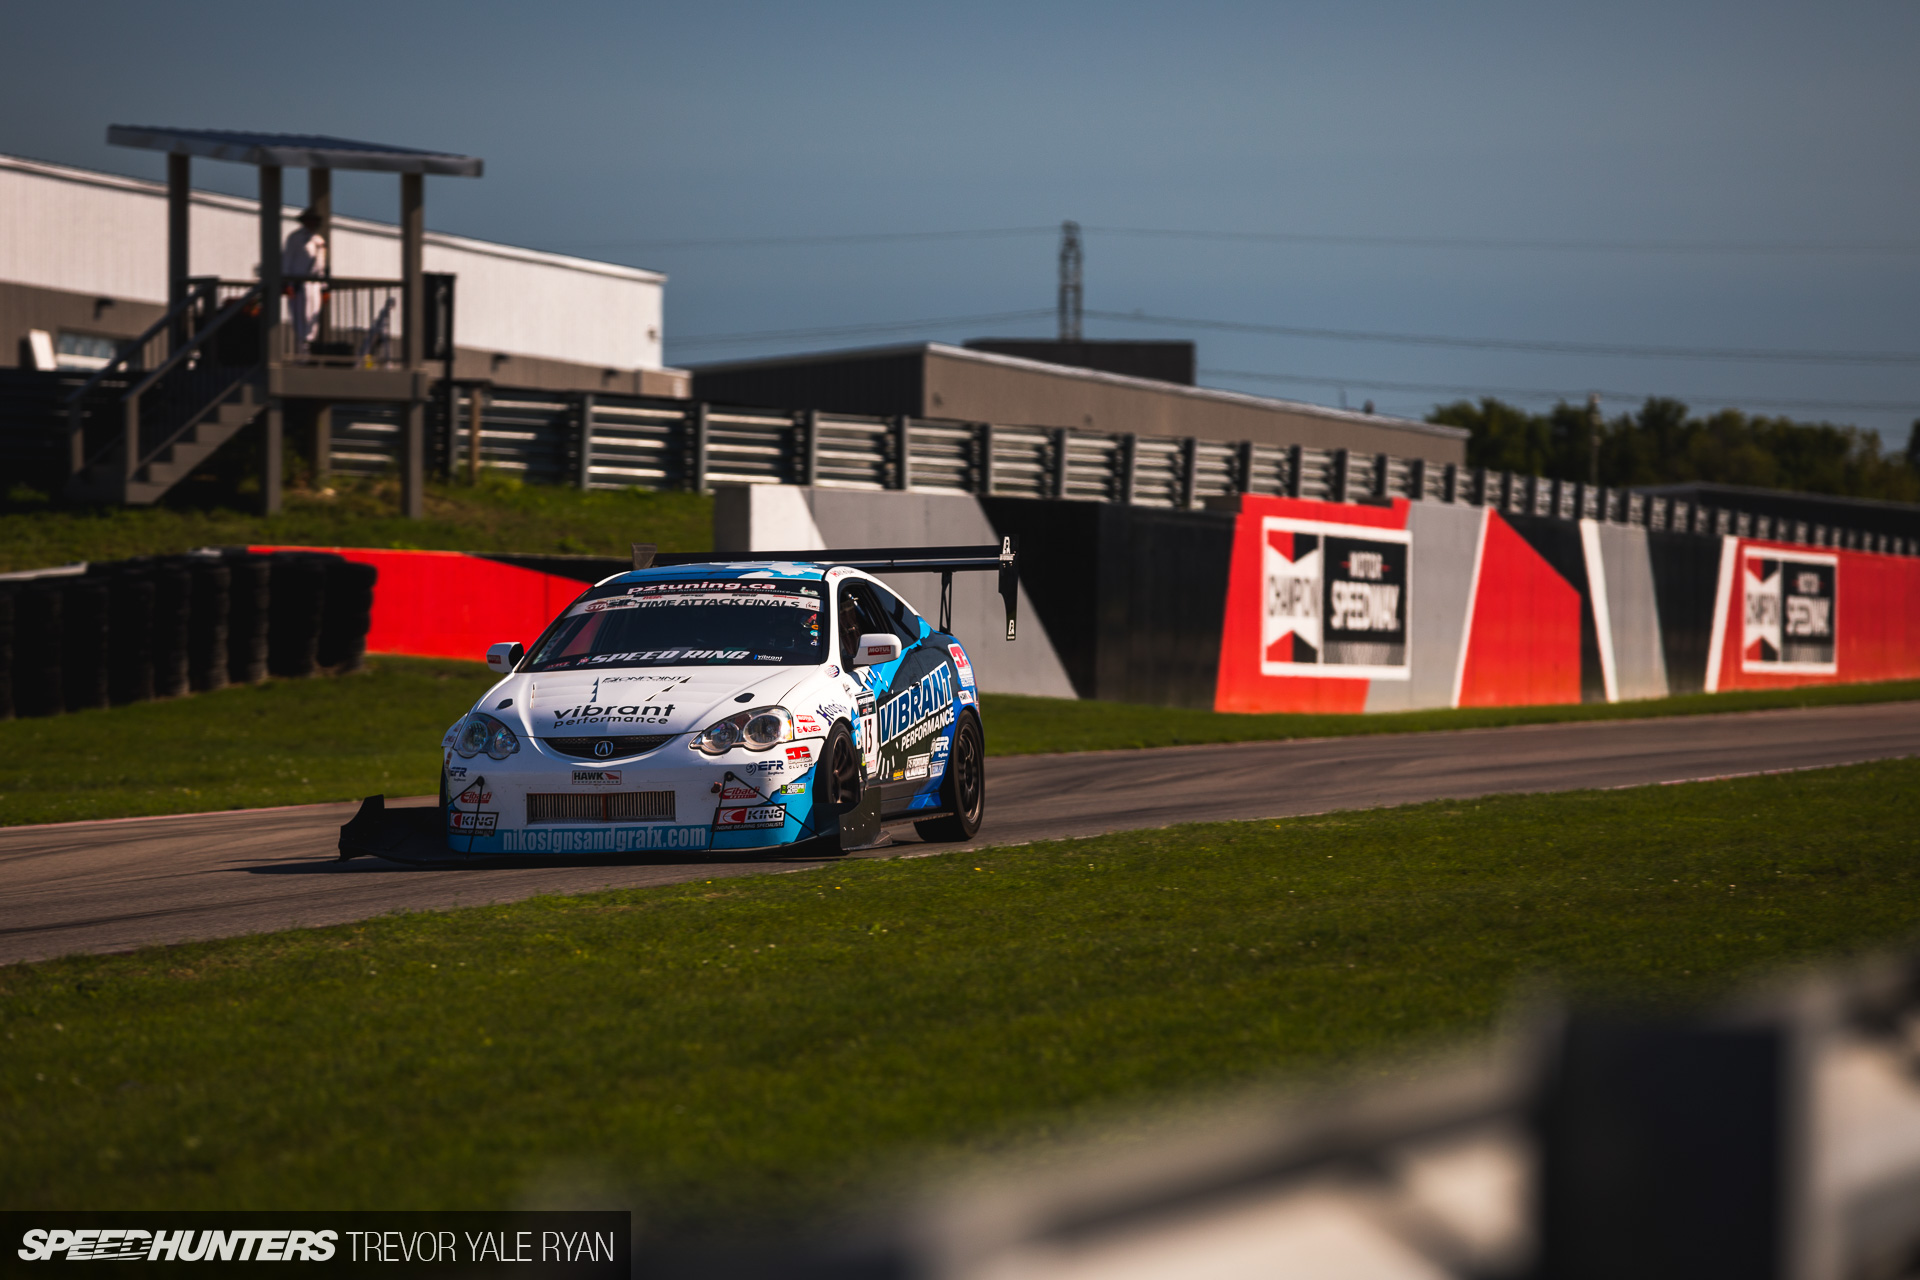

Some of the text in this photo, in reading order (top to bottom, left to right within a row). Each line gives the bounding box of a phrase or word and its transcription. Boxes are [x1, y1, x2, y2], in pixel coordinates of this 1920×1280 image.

[627, 582, 777, 595] pztuning.ca
[675, 598, 744, 607] ATTACK
[743, 599, 800, 608] FINALS
[588, 651, 680, 665] SPEED
[680, 650, 750, 660] RING
[879, 661, 954, 748] VIBRANT
[553, 704, 676, 720] vibrant
[553, 716, 669, 729] performance
[901, 706, 955, 752] PERFORMANCE
[864, 718, 873, 755] 13
[758, 760, 784, 771] EFR
[573, 772, 604, 781] HAWK
[720, 786, 760, 799] Eibach
[461, 815, 495, 827] KING
[747, 809, 784, 820] KING
[503, 827, 706, 854] nikosignsandgrafx.com
